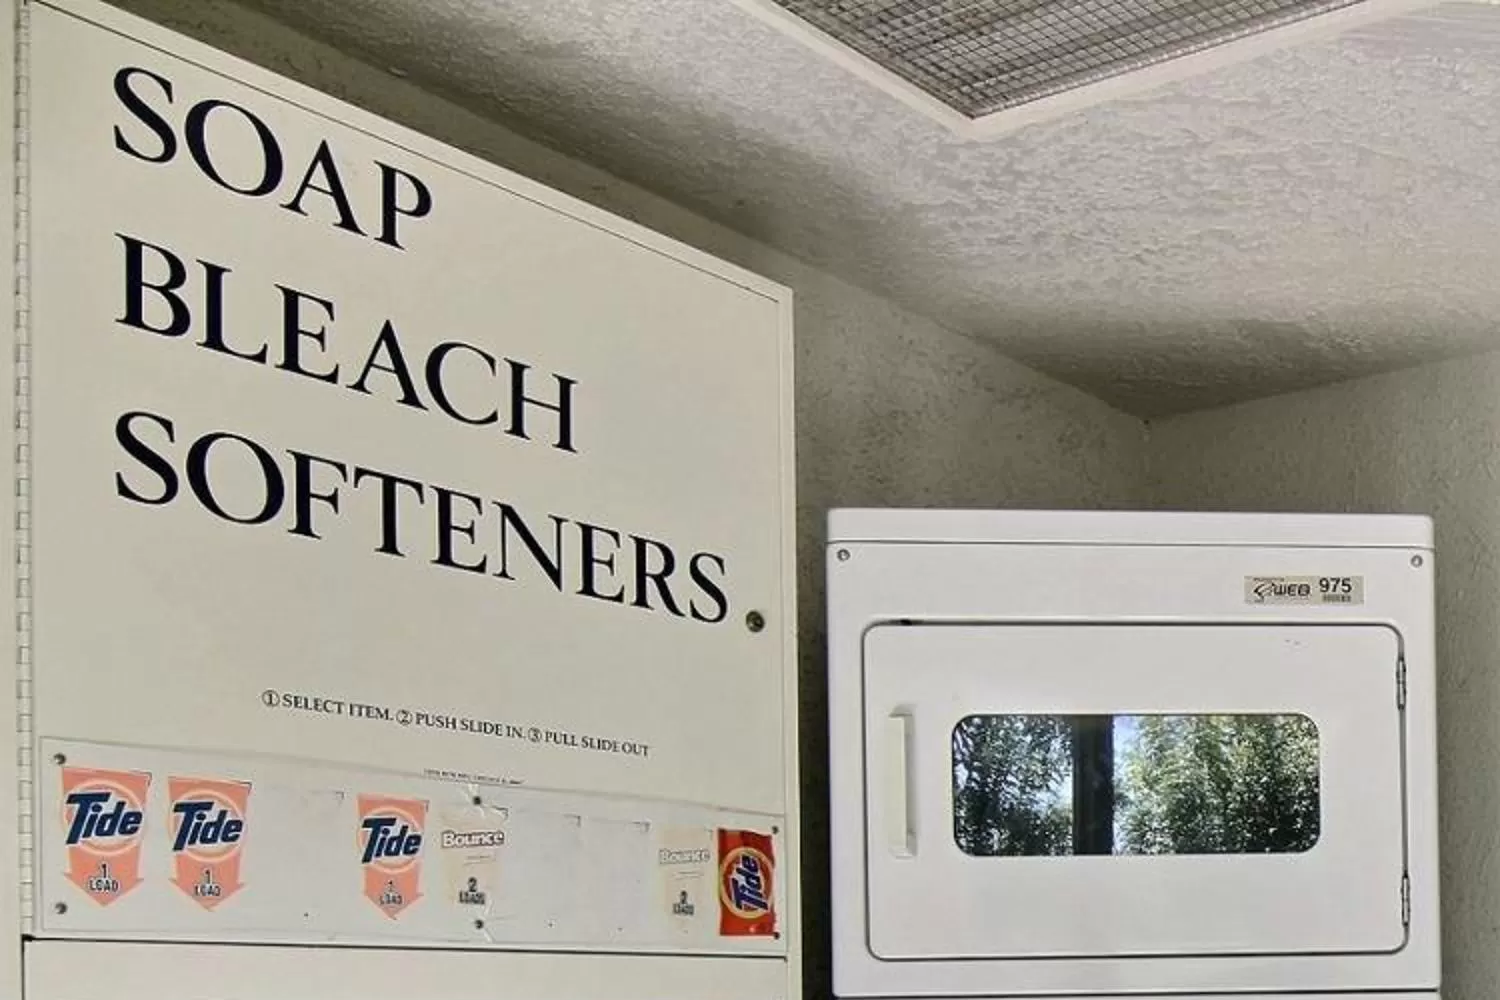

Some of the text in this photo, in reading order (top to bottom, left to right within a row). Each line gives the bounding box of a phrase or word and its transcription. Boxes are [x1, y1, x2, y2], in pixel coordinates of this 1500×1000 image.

[113, 66, 433, 251] SOAP
[115, 233, 579, 454] BLEACH
[115, 411, 730, 625] SOFTENERS
[1319, 578, 1352, 593] 975
[282, 694, 344, 715] SELECT
[349, 703, 394, 721] ITEM.
[415, 713, 457, 730] PUSH
[460, 718, 502, 737] SLIDE
[545, 731, 578, 747] PULL
[581, 735, 618, 752] SLIDE
[622, 741, 649, 757] OUT
[66, 792, 143, 844] Tide
[172, 801, 243, 852] Tide
[361, 818, 422, 864] Tide
[441, 830, 505, 848] Bounce
[89, 878, 119, 892] LOAD
[731, 854, 768, 911] Tide
